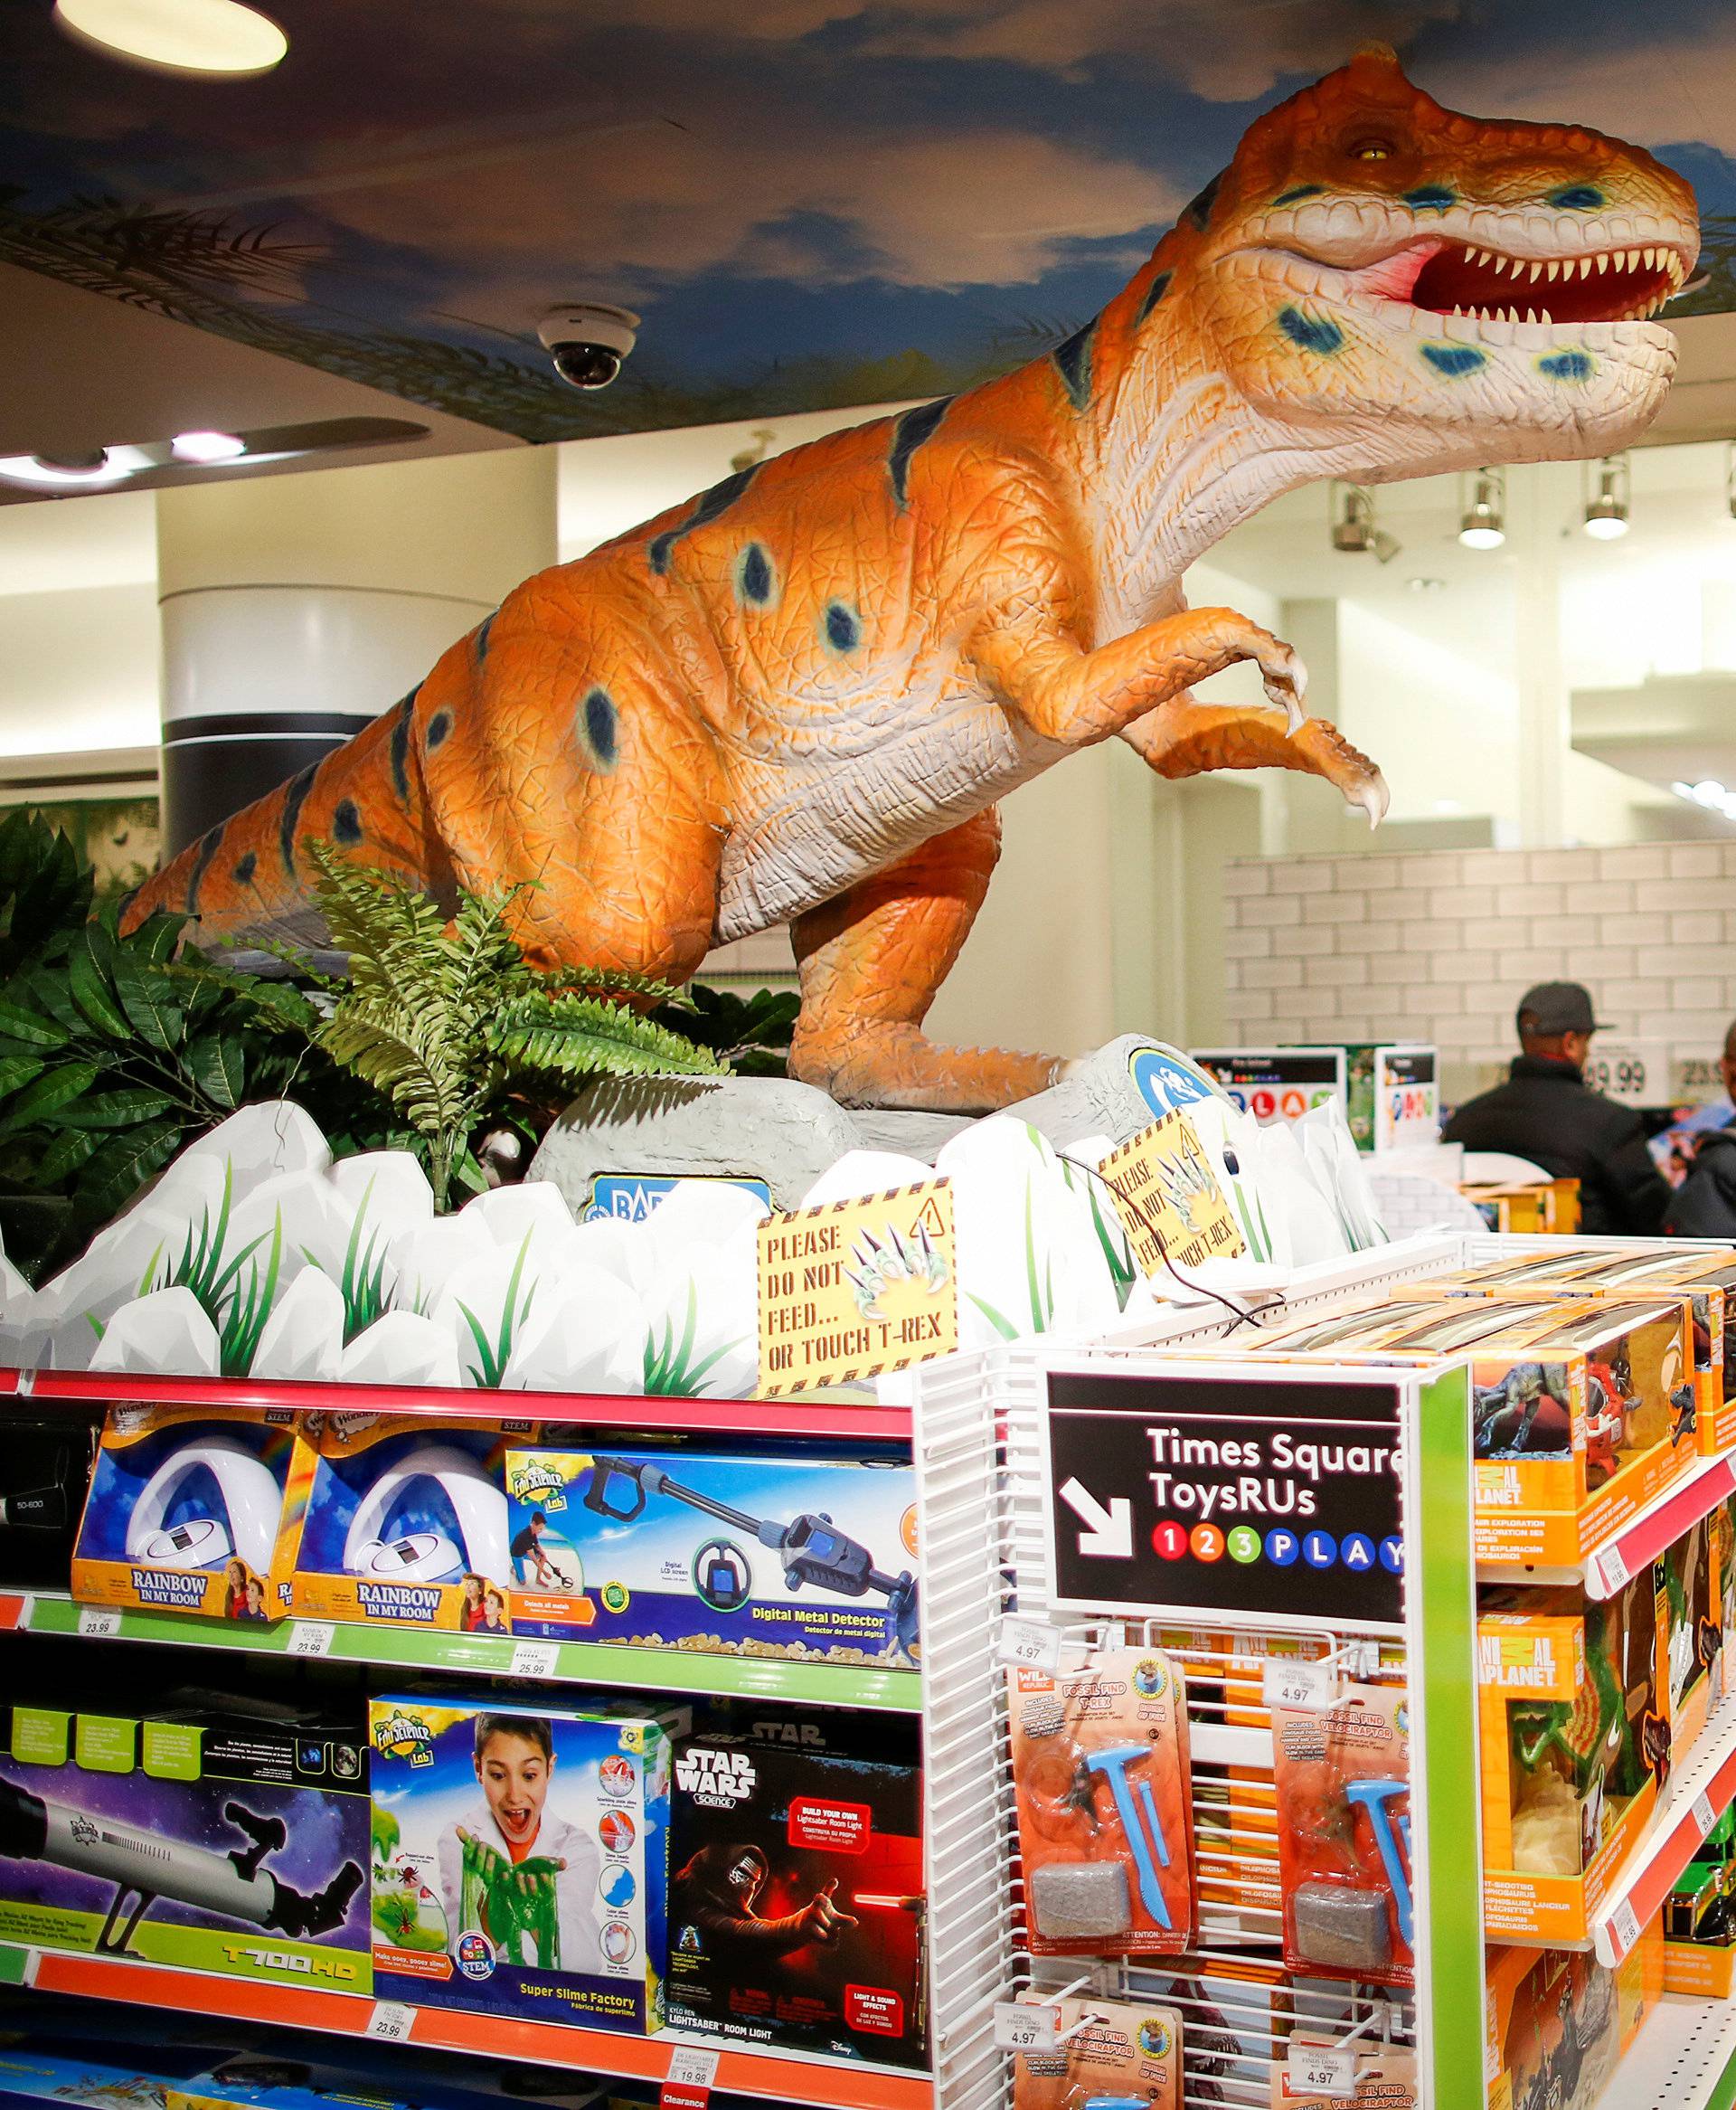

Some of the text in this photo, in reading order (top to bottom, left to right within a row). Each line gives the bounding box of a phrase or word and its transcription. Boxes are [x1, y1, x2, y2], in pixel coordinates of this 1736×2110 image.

[1111, 1158, 1154, 1201] PLEASE
[1142, 1187, 1167, 1220] NOT
[1201, 1216, 1232, 1254] T-REX
[767, 1225, 842, 1263] PLEASE
[767, 1260, 844, 1299] DO NOT
[767, 1301, 839, 1336] FEED...
[768, 1311, 942, 1371] OR TOUCH T-REX
[503, 1421, 530, 1431] STEM
[1146, 1427, 1261, 1467] Times
[547, 1498, 563, 1509] Lab
[1149, 1472, 1316, 1520] ToysRUs
[1476, 1489, 1521, 1505] LANET
[1491, 1519, 1545, 1528] EXPLORATION
[133, 1570, 207, 1594] RAINBOW
[141, 1589, 200, 1606] IN MY ROOM
[358, 1584, 441, 1608] RAINBOW
[367, 1604, 432, 1620] IN MY ROOM
[751, 1607, 886, 1628] Digital Metal Detector
[85, 1623, 110, 1633] 23.99
[804, 1625, 886, 1640] Detector de metal digital
[297, 1642, 321, 1653] 23.99
[1015, 1644, 1041, 1660] 4.97
[519, 1663, 545, 1674] 25.99
[1062, 1681, 1127, 1698] FOSSIL FIND
[1281, 1687, 1308, 1701] 4.97
[1079, 1696, 1111, 1709] T-REX
[1327, 1710, 1385, 1727] FOSSIL FIND
[751, 1721, 826, 1746] STAR
[1320, 1720, 1392, 1740] VELOCIRAPTOR
[412, 1752, 429, 1764] Lab
[675, 1748, 756, 1777] STAR
[675, 1768, 756, 1799] WARS
[698, 1794, 731, 1806] SCIENCE
[802, 1806, 858, 1821] BUILD YOUR OWN
[797, 1814, 863, 1831] Lightsaber Room Light
[839, 1831, 857, 1839] PROPIA
[1533, 1902, 1571, 1911] LANCEUR
[222, 1945, 358, 1981] T700HD
[374, 1952, 392, 1961] Make
[392, 1955, 409, 1963] ooey,
[409, 1958, 429, 1967] gooey
[429, 1960, 447, 1969] slime!
[462, 1961, 491, 1972] STEM
[520, 1982, 636, 2010] Super Slime Factory
[854, 1992, 871, 2001] LIGHT
[876, 1996, 896, 2005] SOUND
[604, 2007, 636, 2017] superlimo
[668, 2007, 695, 2018] KYLO REN
[862, 2001, 887, 2011] EFFECTS
[375, 2020, 401, 2038] 23.99
[724, 2022, 747, 2036] ROOM
[749, 2028, 773, 2040] LIGHT
[1105, 2030, 1129, 2044] FIND
[1011, 2031, 1036, 2045] 4.97
[830, 2039, 852, 2055] Disney
[1065, 2037, 1136, 2058] VELOCIRAPTOR
[681, 2071, 707, 2084] 19.98
[1138, 2069, 1151, 2078] OF
[1307, 2071, 1334, 2084] 4.97
[1378, 2084, 1406, 2097] FIND
[663, 2094, 705, 2109] Clearance
[1330, 2096, 1414, 2110] VELOCIRAPTOR
